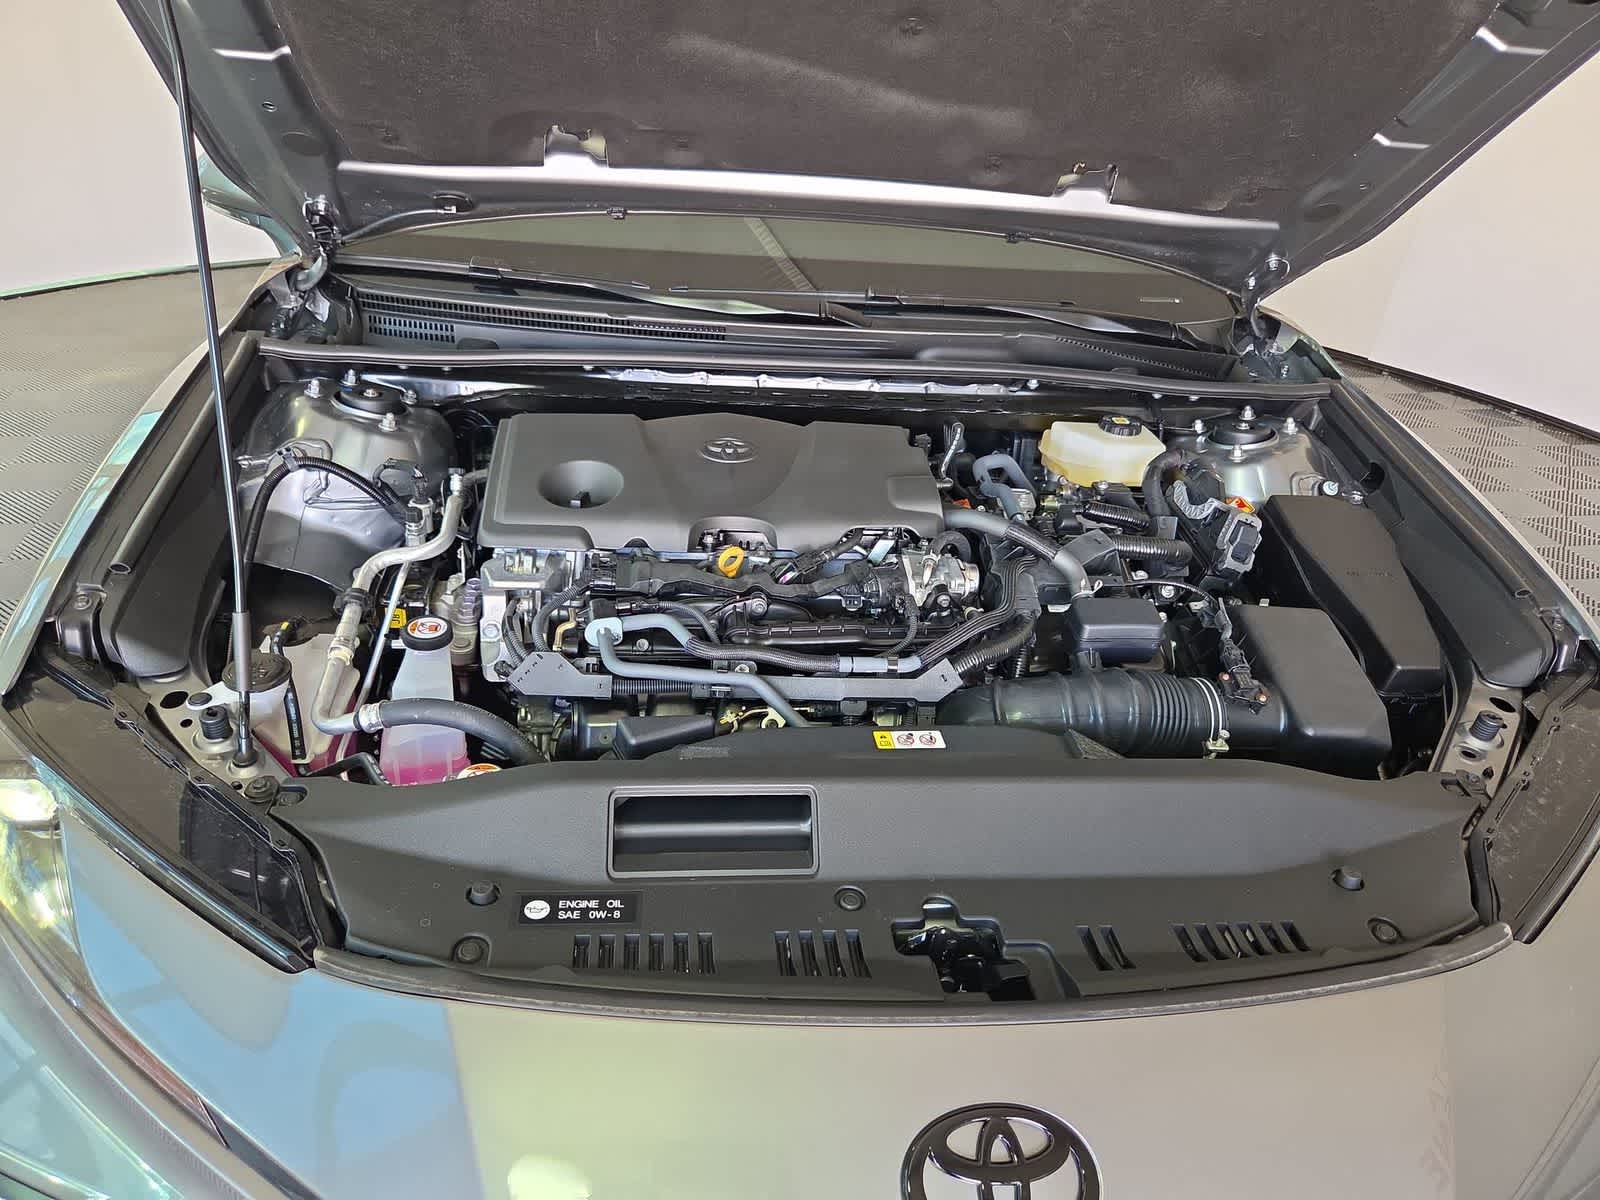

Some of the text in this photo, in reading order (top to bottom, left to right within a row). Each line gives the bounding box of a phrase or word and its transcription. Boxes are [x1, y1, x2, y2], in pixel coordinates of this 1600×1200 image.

[558, 899, 625, 909] ENGINE OIL
[557, 910, 621, 920] SAE 0W-8
